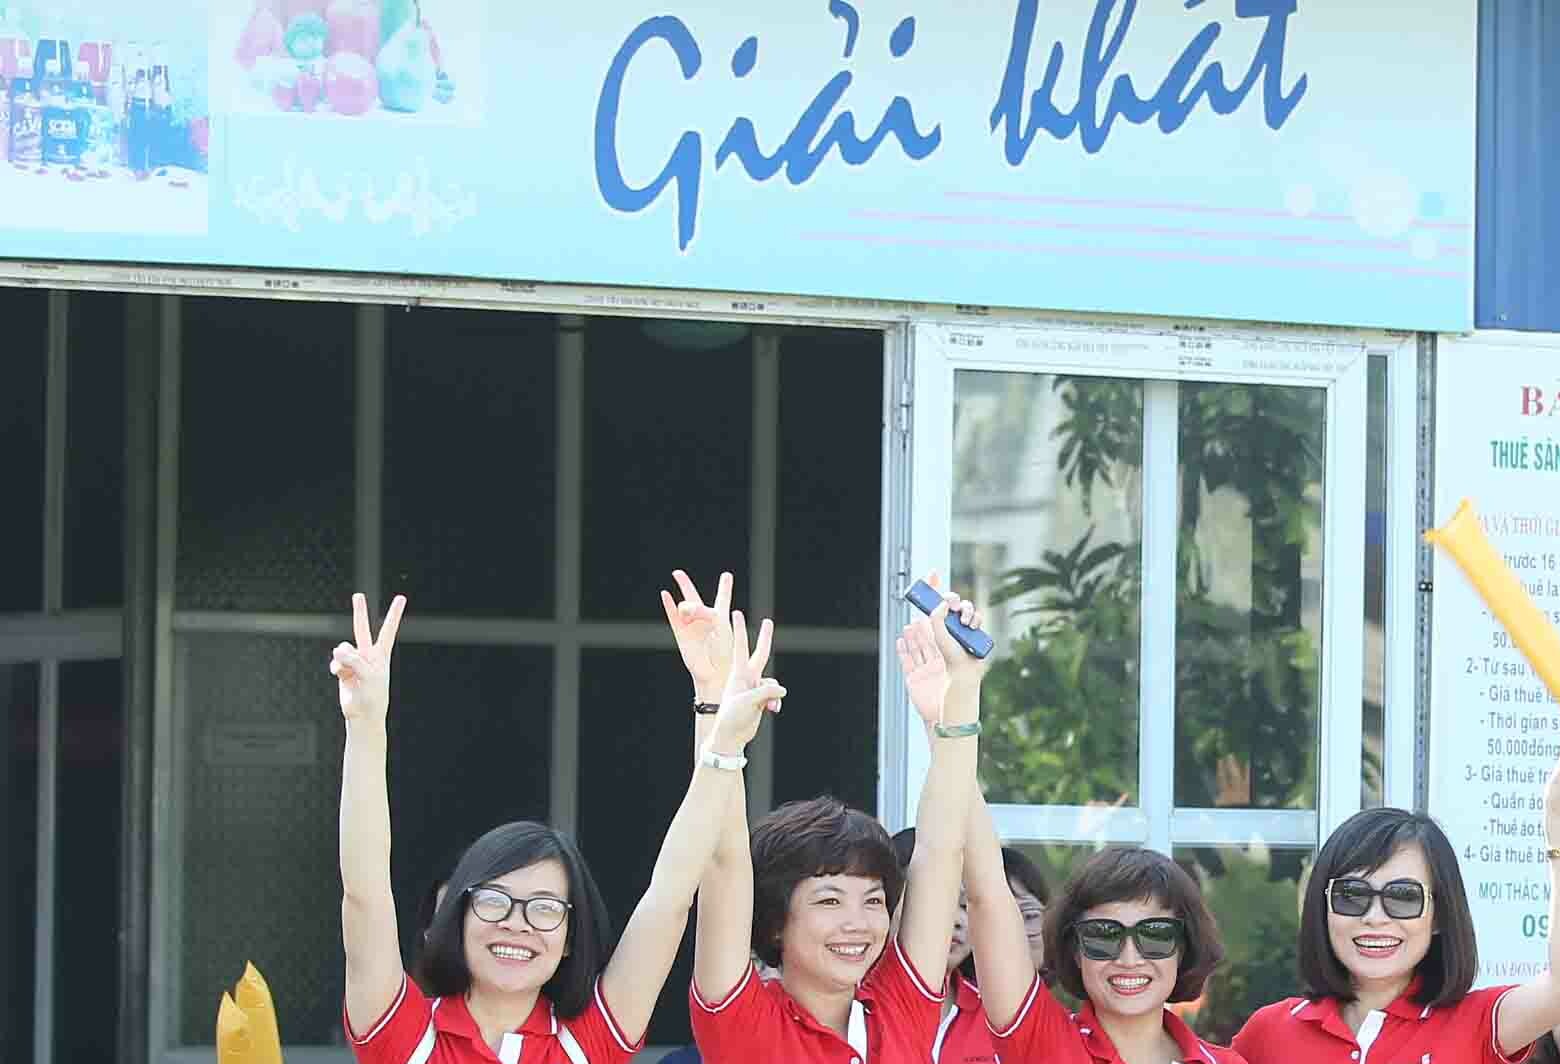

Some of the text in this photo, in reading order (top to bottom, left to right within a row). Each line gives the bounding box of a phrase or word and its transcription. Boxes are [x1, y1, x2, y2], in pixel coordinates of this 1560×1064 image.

[594, 0, 942, 251] Giải
[1490, 436, 1529, 470] THUÊ
[1542, 553, 1555, 571] 16
